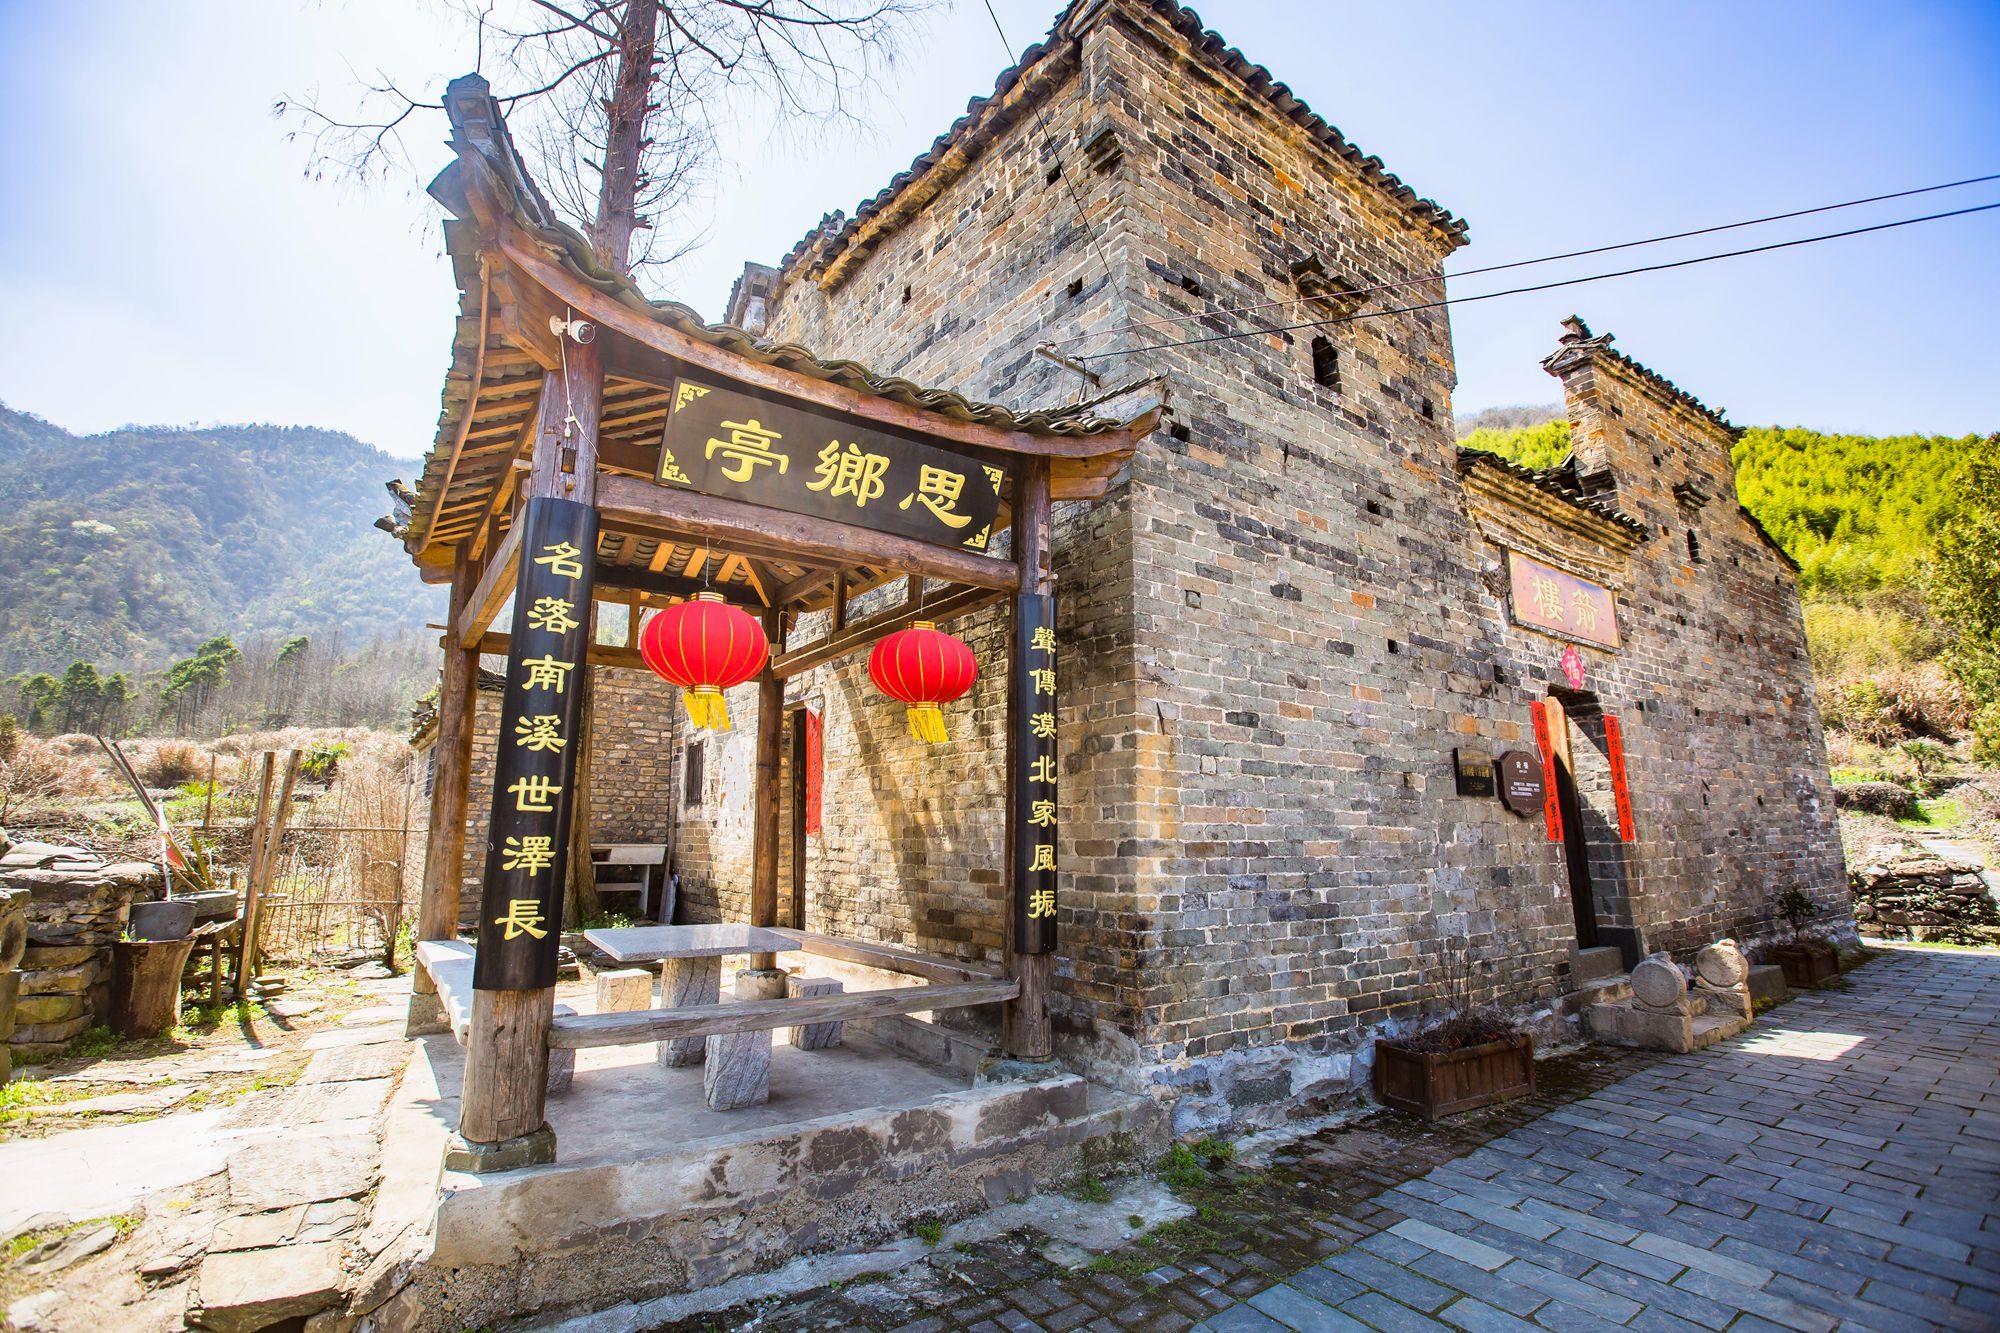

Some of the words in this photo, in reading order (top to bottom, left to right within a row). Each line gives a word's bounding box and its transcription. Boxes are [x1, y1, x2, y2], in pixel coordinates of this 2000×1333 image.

[705, 419, 972, 529] 思鄉亭
[494, 540, 583, 942] 名落南溪世澤長
[1565, 653, 1580, 682] 福
[1027, 626, 1057, 919] 聲傳漠北家風振
